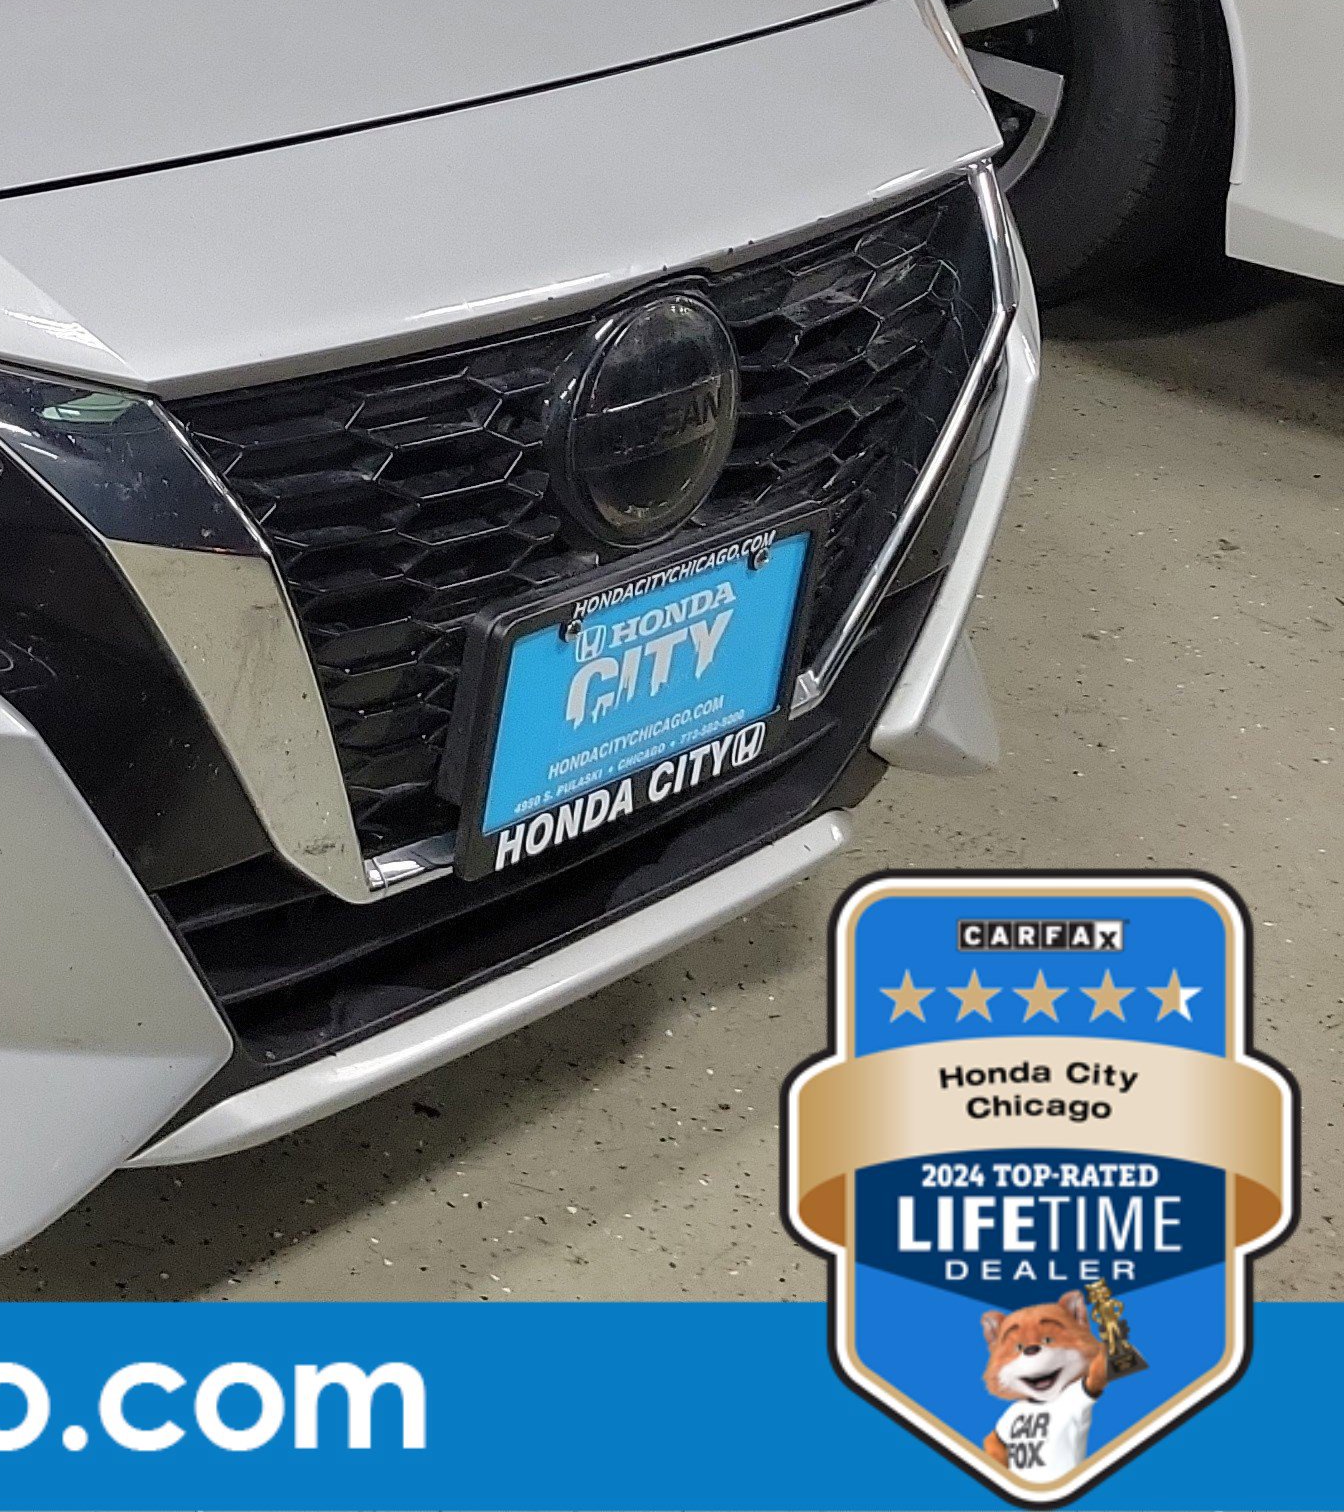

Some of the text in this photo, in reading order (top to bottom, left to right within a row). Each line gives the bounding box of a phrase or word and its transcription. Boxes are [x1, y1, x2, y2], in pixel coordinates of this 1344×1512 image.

[572, 529, 776, 619] HONDACITYCHICAGO.COM
[609, 581, 737, 648] HONDA
[565, 608, 734, 730] CITY
[547, 694, 725, 780] HONDACITYCHICAGO.COM
[617, 742, 666, 771] CHICAGO
[495, 733, 734, 871] HONDA CITY
